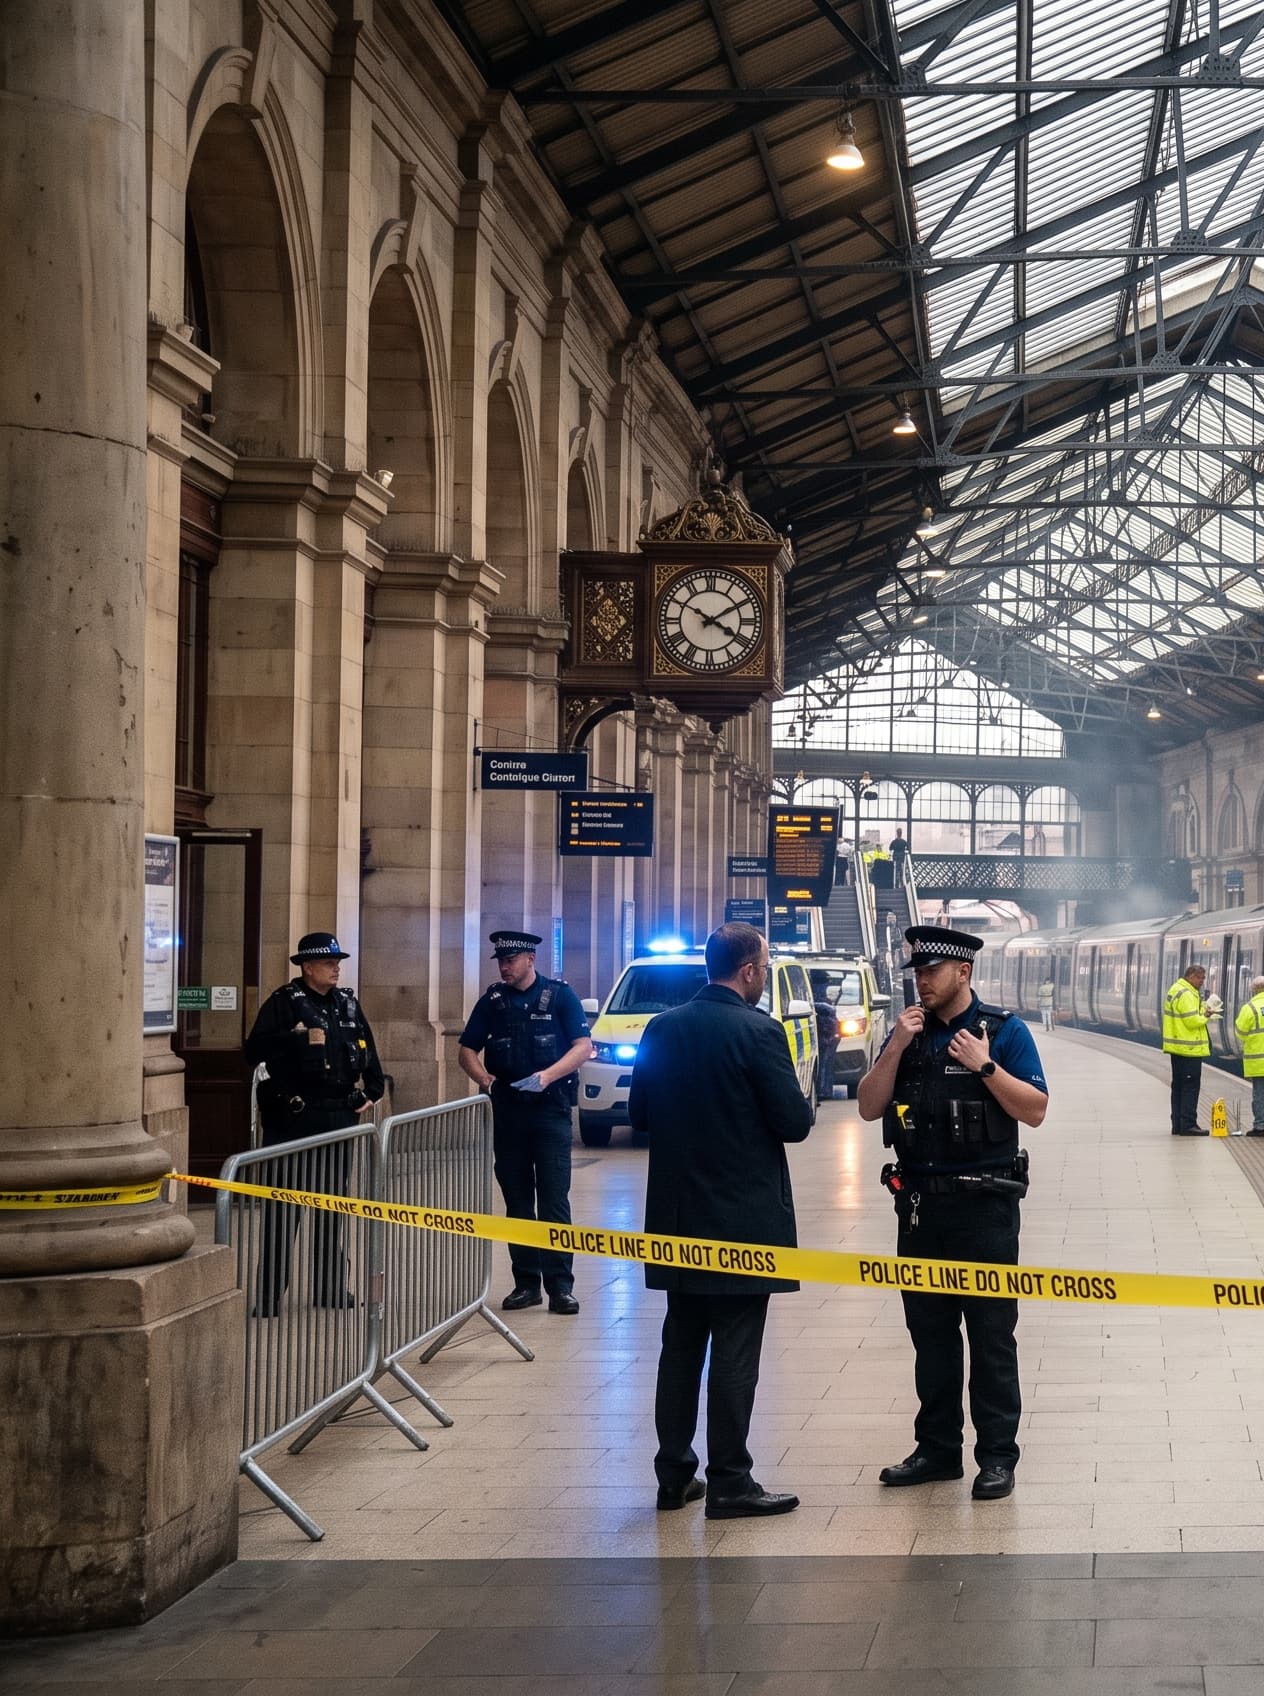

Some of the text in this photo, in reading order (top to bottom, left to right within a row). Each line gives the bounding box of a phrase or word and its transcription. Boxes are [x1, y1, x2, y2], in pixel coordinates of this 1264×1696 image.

[388, 1209, 419, 1224] NOT
[424, 1213, 475, 1233] CROSS
[549, 1228, 776, 1272] POLICE LINE DO NOT CROSS
[859, 1261, 1117, 1300] POLICE LINE DO NOT CROSS
